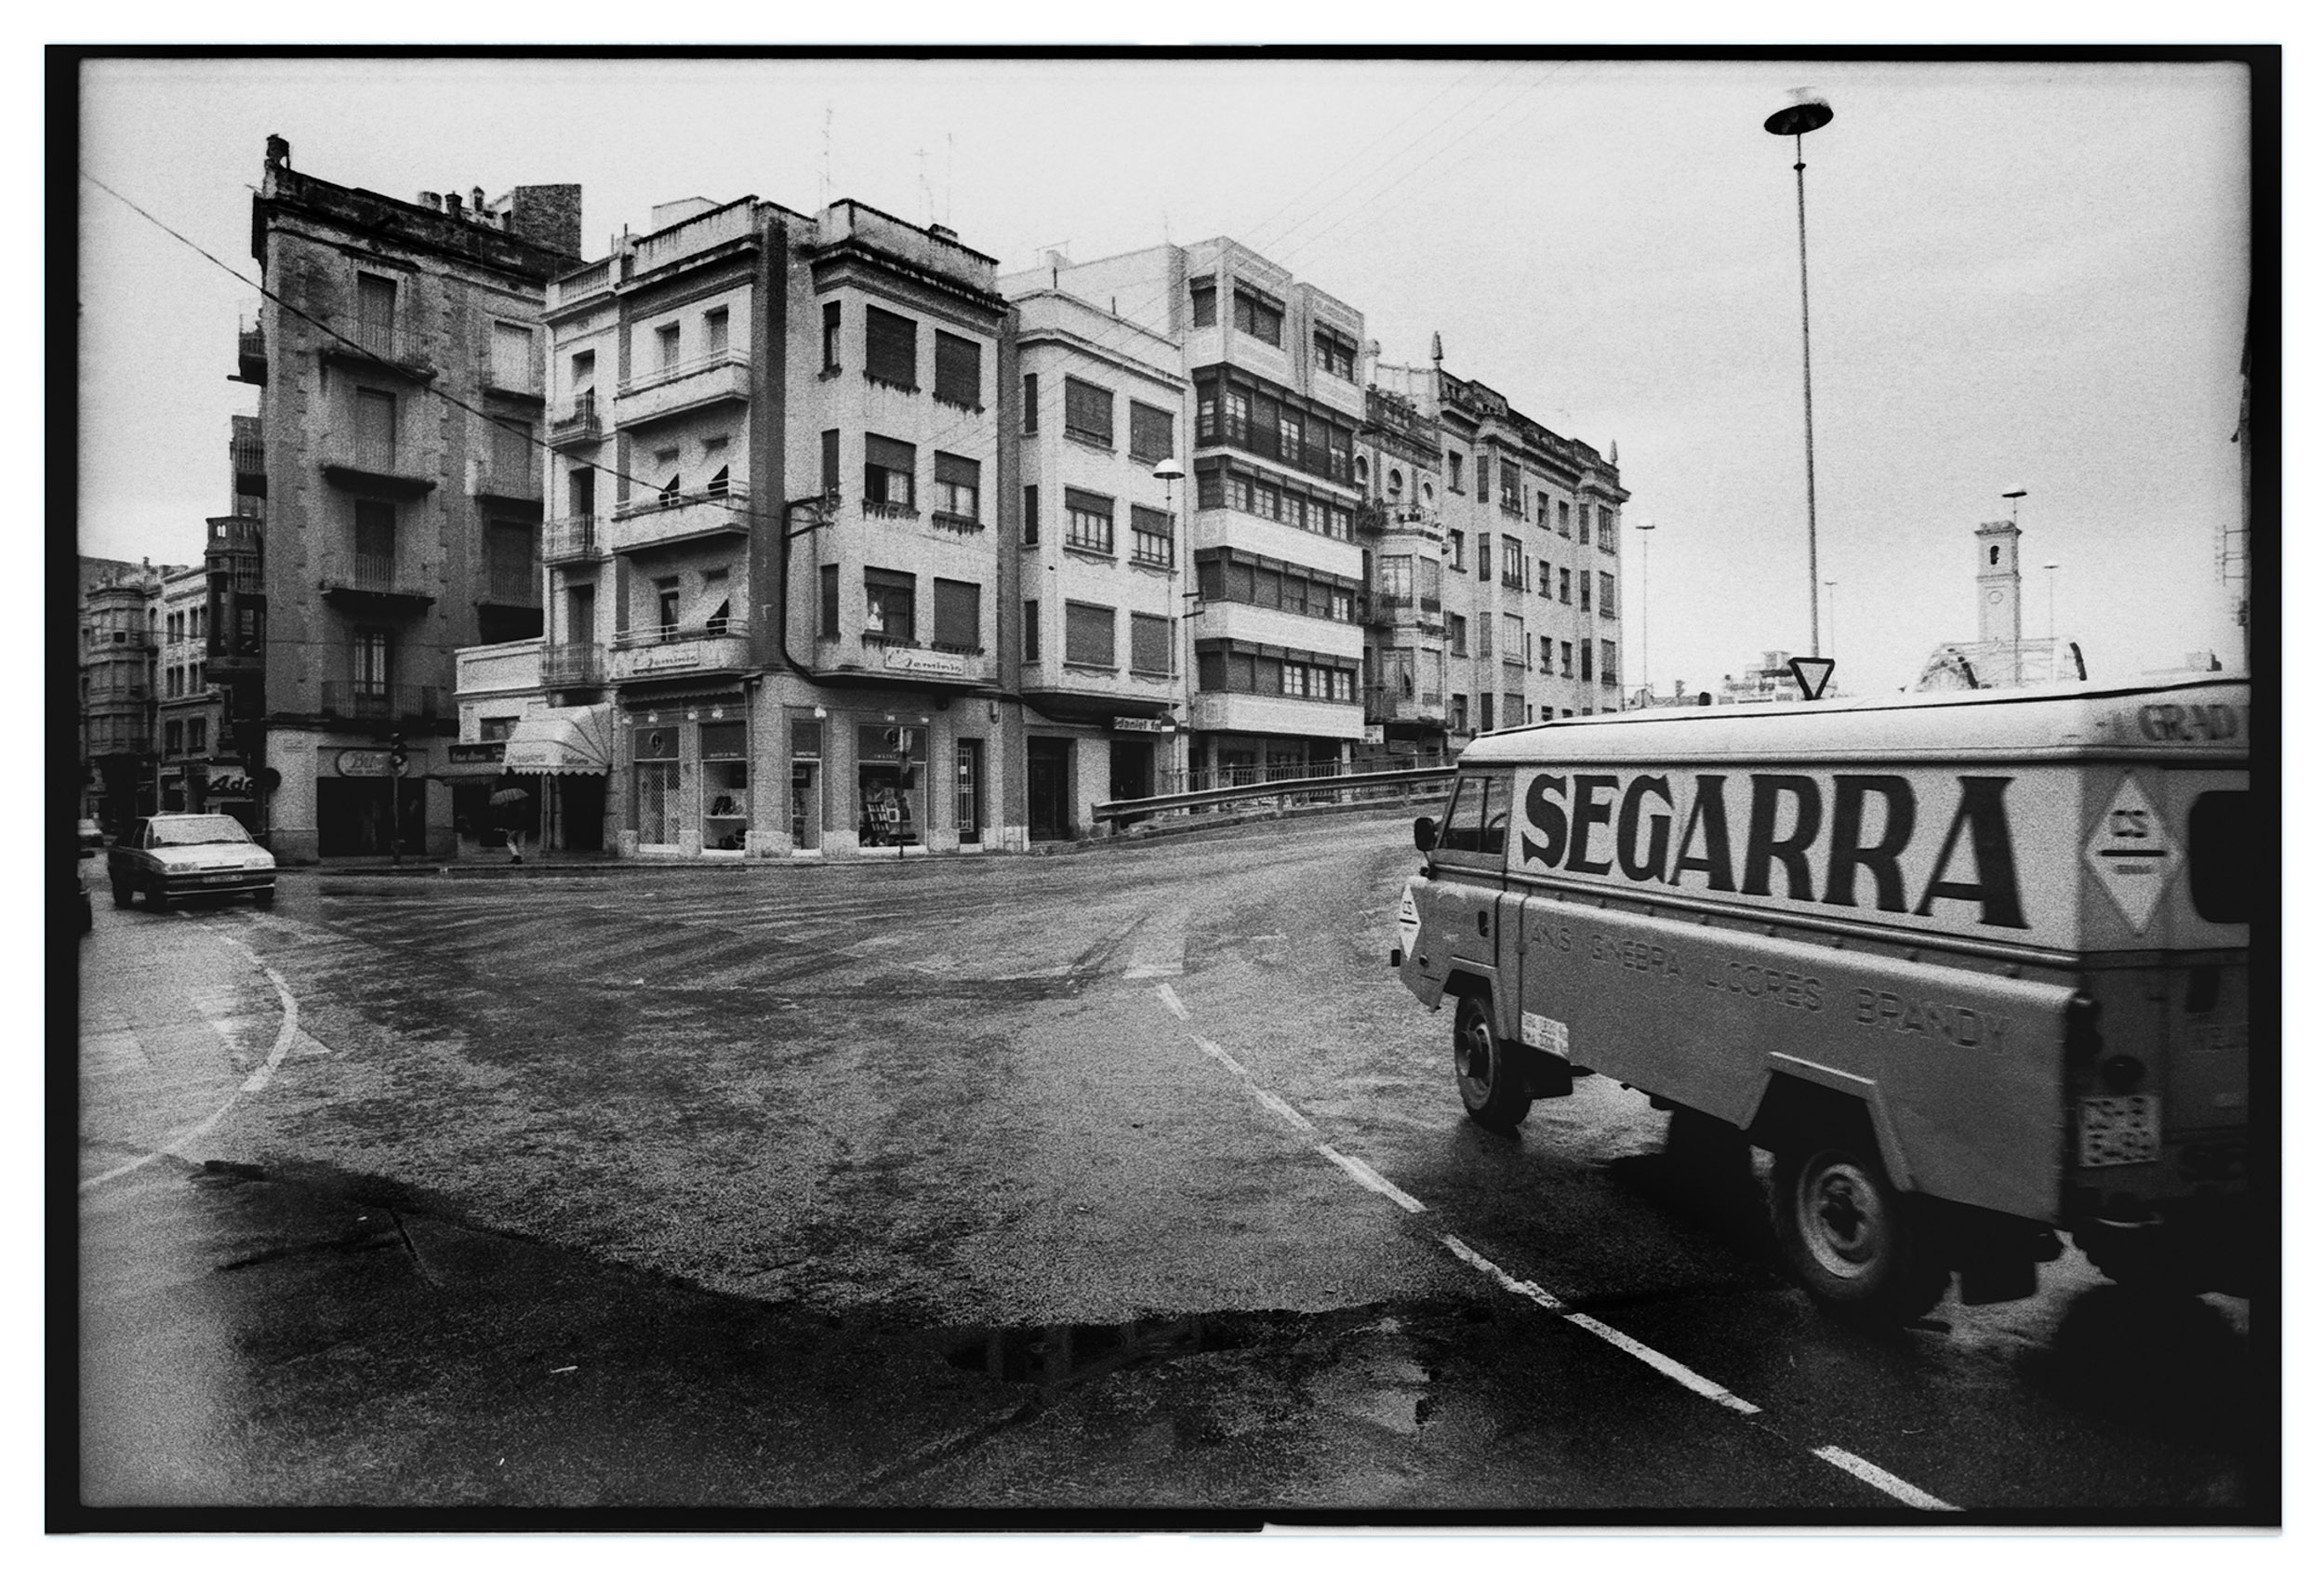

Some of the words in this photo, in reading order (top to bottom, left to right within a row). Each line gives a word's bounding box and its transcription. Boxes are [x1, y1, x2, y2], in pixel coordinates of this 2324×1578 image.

[1521, 773, 2032, 931] SEGARRA
[1591, 934, 1684, 982] GINEBRA
[1705, 950, 1825, 1014] LICORES
[1855, 986, 2014, 1056] BRANDY
